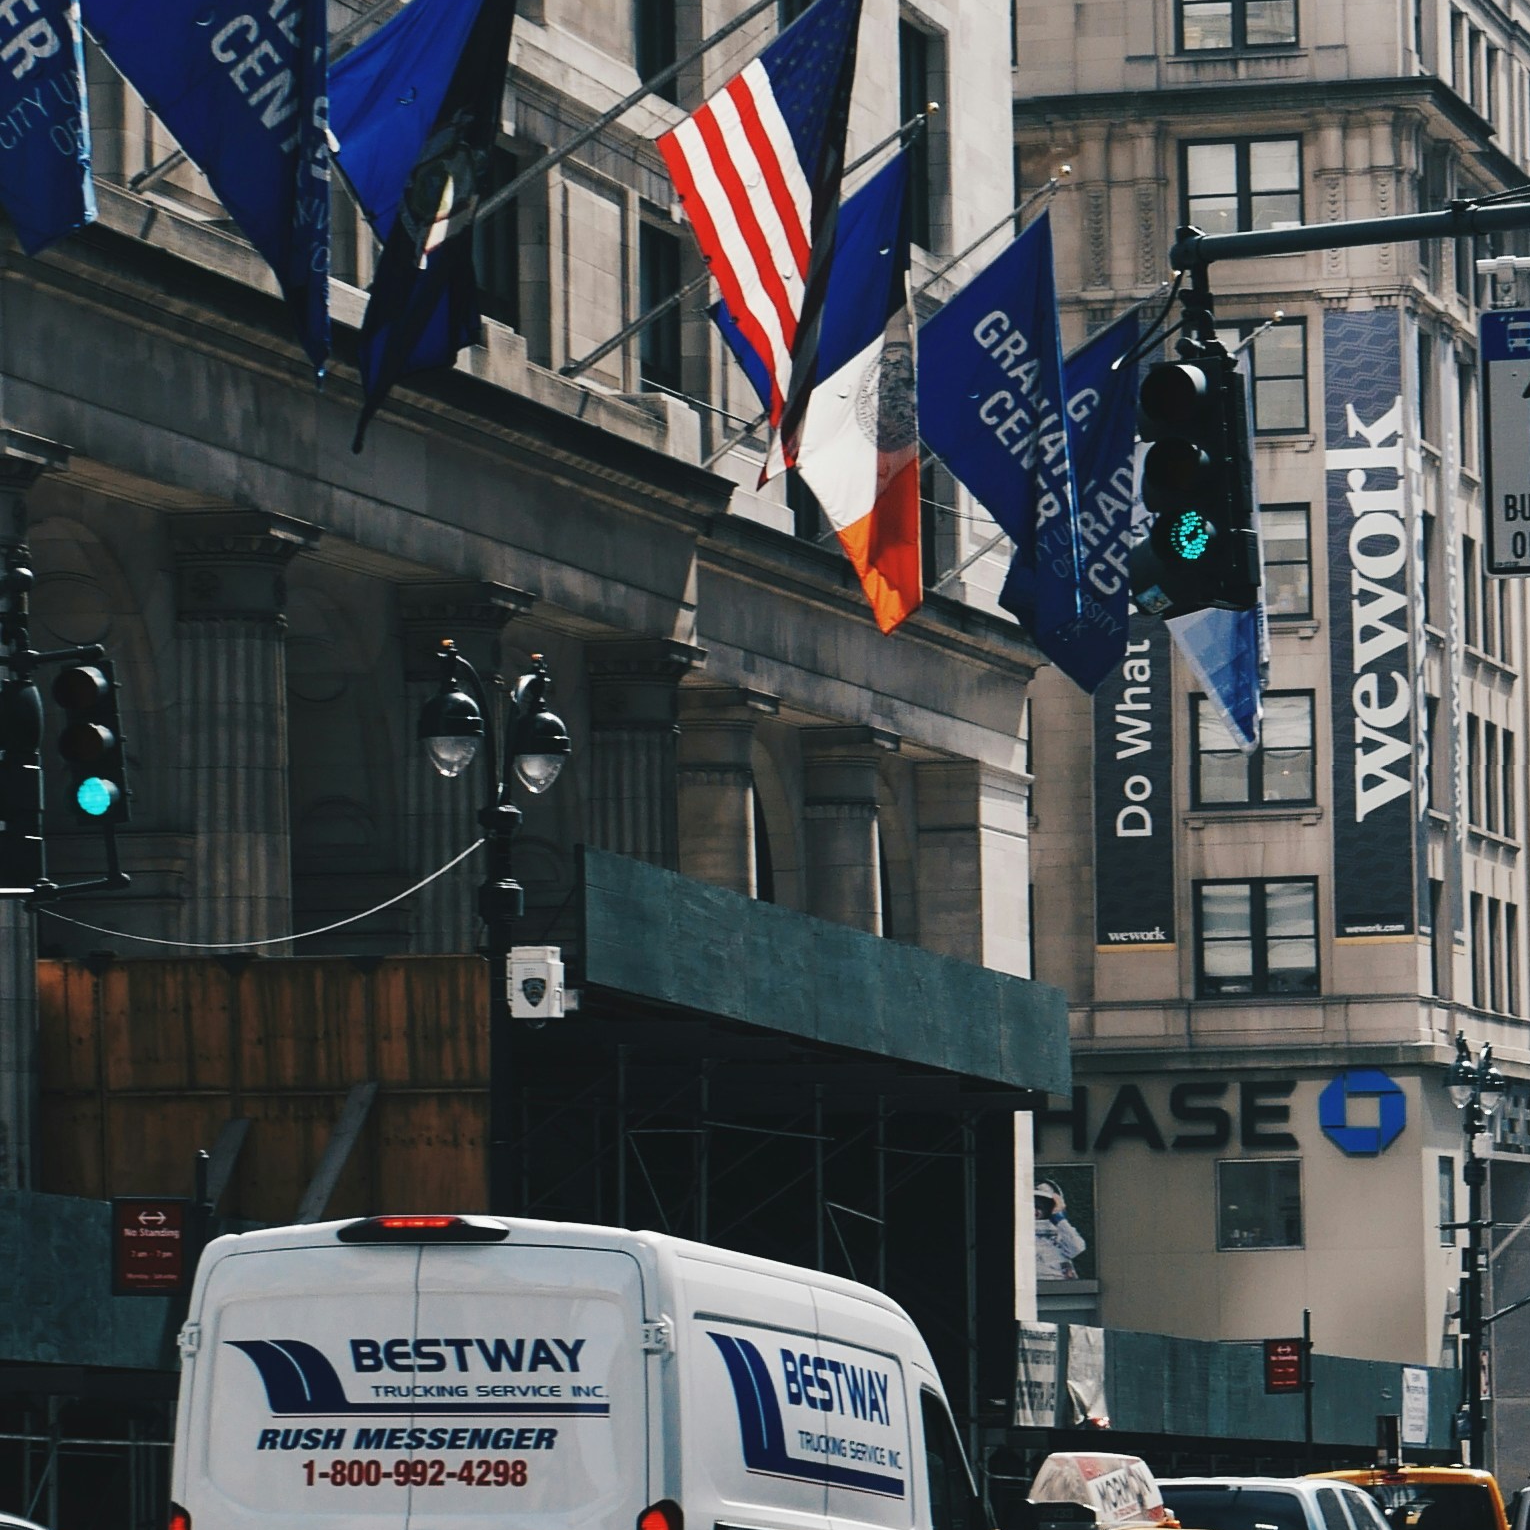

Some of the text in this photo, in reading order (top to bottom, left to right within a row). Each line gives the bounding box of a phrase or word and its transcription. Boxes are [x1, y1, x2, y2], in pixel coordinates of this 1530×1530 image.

[1324, 397, 1413, 823] wework
[1115, 639, 1152, 837] Do What
[1108, 926, 1167, 941] wework
[1345, 923, 1405, 934] wework.com
[139, 1228, 180, 1239] Standing
[350, 1339, 586, 1373] BESTWAY
[371, 1385, 609, 1398] TRUCKING SERVICE INC.
[780, 1348, 890, 1426] BESTWAY
[257, 1428, 558, 1450] RUSH MESSENGER
[798, 1430, 847, 1458] TRUCKING
[849, 1439, 886, 1466] SERVICE
[302, 1459, 528, 1487] 1-800-992-4298
